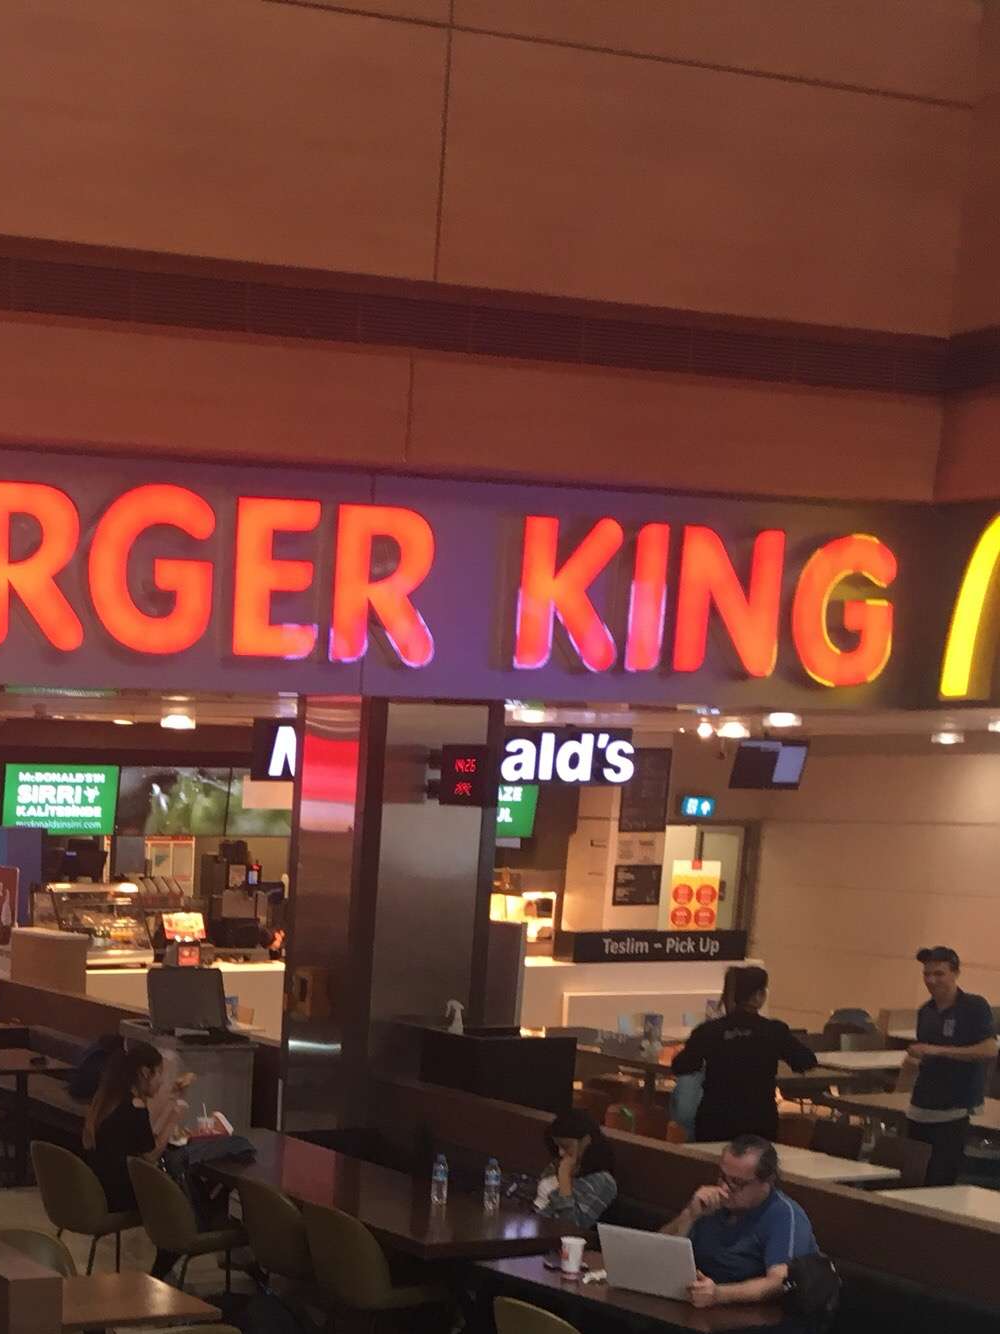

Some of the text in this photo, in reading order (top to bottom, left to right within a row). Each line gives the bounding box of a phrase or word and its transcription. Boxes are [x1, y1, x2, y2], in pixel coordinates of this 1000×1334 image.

[512, 514, 898, 688] KING
[16, 784, 82, 804] SIRRI
[602, 937, 649, 954] Teslim
[666, 937, 696, 953] Pick
[700, 937, 720, 956] Up
